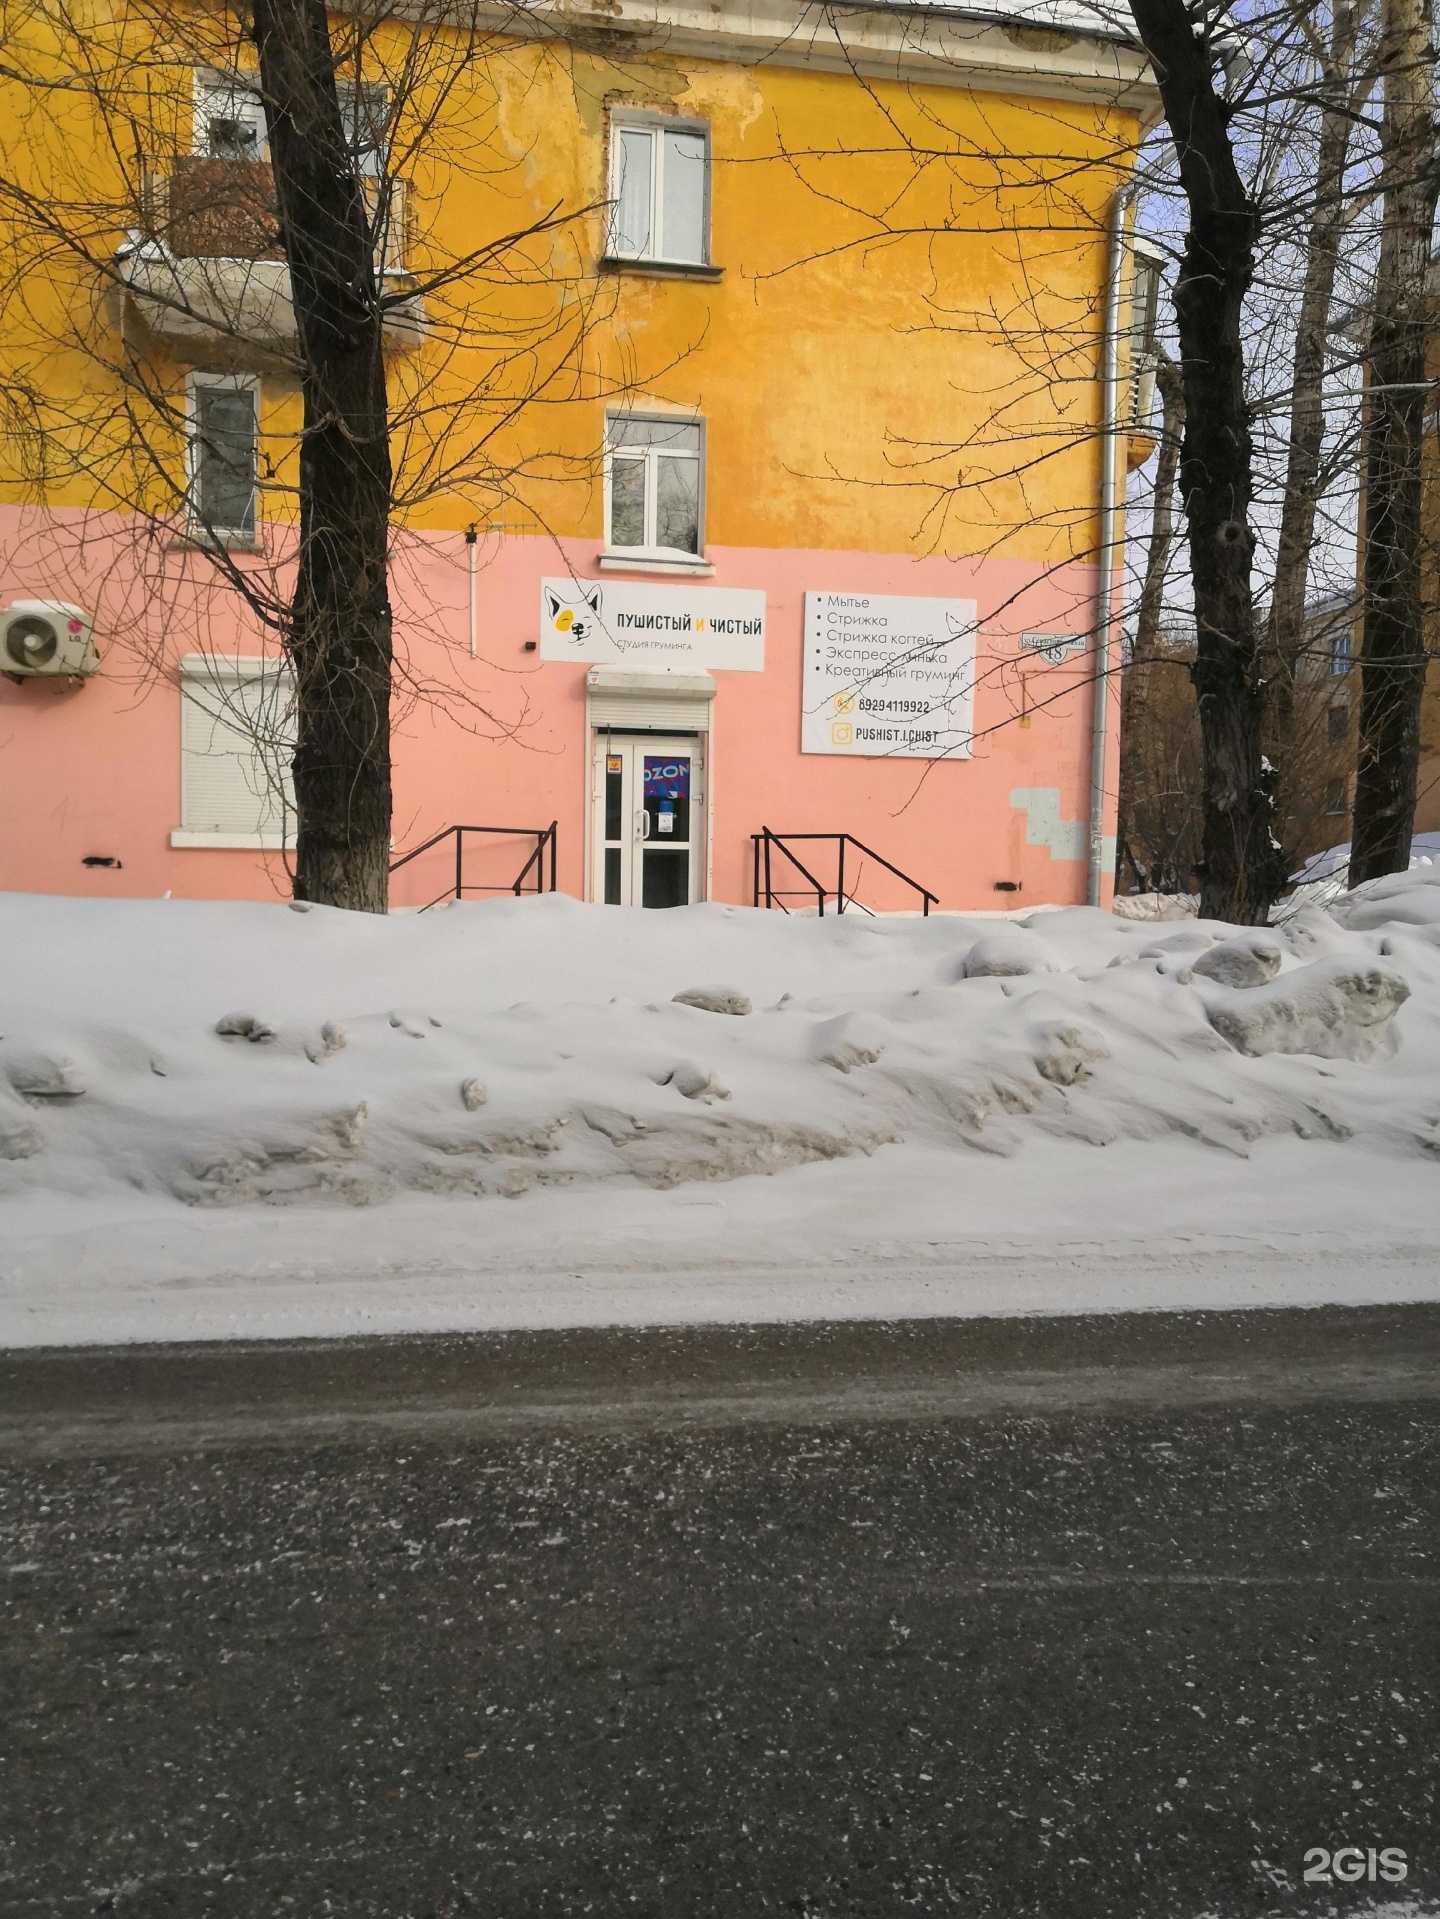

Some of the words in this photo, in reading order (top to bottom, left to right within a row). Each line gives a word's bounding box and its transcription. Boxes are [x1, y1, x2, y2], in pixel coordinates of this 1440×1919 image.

[827, 595, 870, 608] Мытье
[617, 613, 691, 632] ПУШИСТЫЙ
[695, 617, 705, 632] И
[709, 617, 763, 636] ЧИСТЫЙ
[826, 612, 888, 626] Стрижка
[617, 639, 650, 650] СТУДИЯ
[650, 641, 693, 650] ГРУМИНГА
[826, 629, 887, 644] Стрижка
[891, 634, 934, 645] когтей
[825, 664, 907, 679] Креативный
[911, 671, 965, 681] груминг
[858, 698, 930, 713] 89294119922
[856, 727, 938, 743] PUSHIST.I.CHIST
